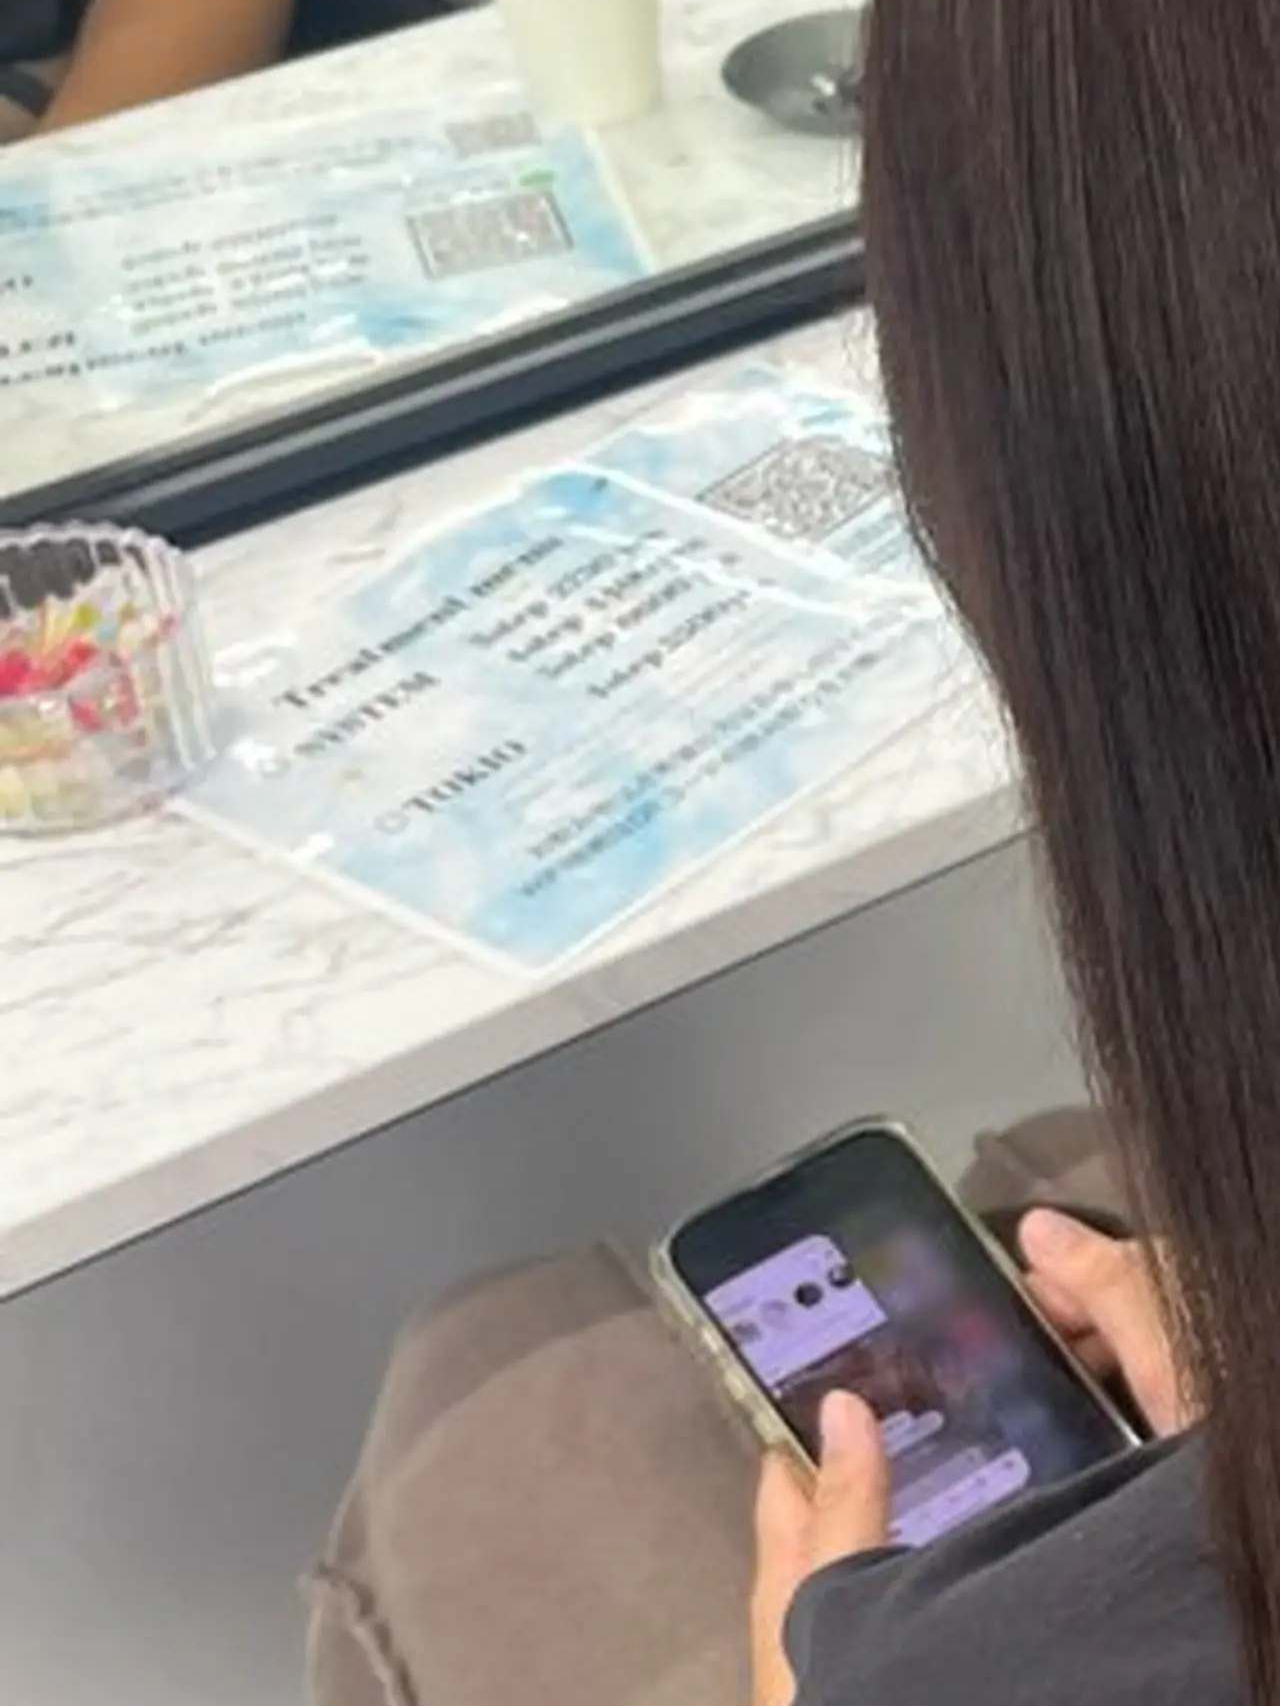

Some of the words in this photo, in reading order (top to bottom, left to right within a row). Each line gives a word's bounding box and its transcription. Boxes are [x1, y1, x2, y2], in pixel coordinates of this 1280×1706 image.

[271, 595, 469, 709] Treatment
[469, 537, 565, 598] menu
[401, 740, 526, 813] TOKIO
